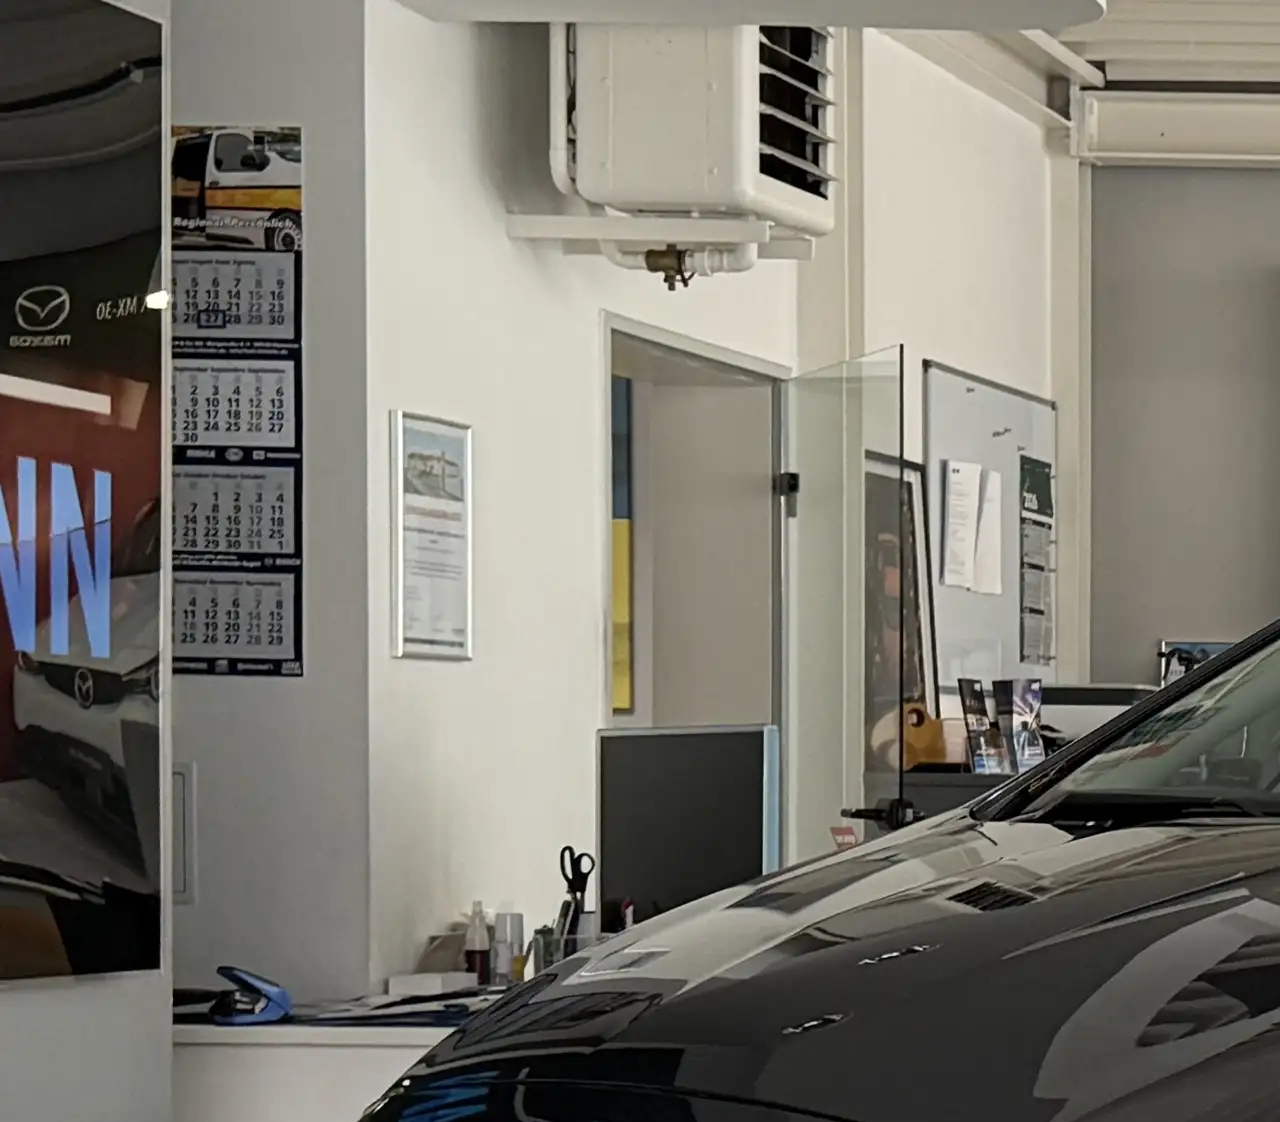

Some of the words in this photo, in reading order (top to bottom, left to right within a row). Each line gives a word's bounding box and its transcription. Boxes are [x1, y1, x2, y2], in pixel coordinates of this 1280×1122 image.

[191, 277, 199, 288] 5
[212, 277, 220, 288] 6
[234, 278, 241, 288] 7
[276, 278, 285, 289] 9
[184, 289, 198, 299] 12
[205, 290, 219, 300] 13
[227, 290, 241, 300] 14
[249, 290, 262, 301] 15
[270, 290, 284, 301] 16
[184, 301, 199, 311] 19
[205, 301, 220, 311] 20
[226, 302, 240, 312] 21
[249, 302, 262, 313] 22
[268, 303, 284, 314] 23
[183, 313, 197, 323] 26
[205, 313, 219, 323] 27
[226, 314, 241, 324] 28
[247, 314, 263, 325] 29
[268, 314, 285, 325] 30
[190, 385, 198, 396] 2
[212, 385, 219, 396] 3
[232, 385, 241, 396] 4
[254, 386, 262, 396] 5
[276, 386, 284, 397] 6
[191, 396, 199, 408] 9
[205, 397, 220, 408] 10
[227, 398, 240, 408] 11
[249, 398, 262, 408] 12
[271, 398, 284, 409] 13
[184, 408, 198, 419] 16
[205, 409, 219, 420] 17
[226, 409, 241, 420] 18
[248, 410, 263, 420] 19
[268, 410, 284, 421] 20
[183, 420, 198, 431] 23
[203, 421, 219, 432] 24
[225, 421, 241, 432] 25
[247, 422, 262, 432] 26
[268, 422, 284, 433] 27
[183, 432, 198, 442] 30
[212, 492, 219, 502] 1
[233, 492, 241, 502] 2
[255, 492, 262, 503] 3
[276, 493, 284, 503] 4
[190, 502, 198, 513] 7
[211, 503, 219, 514] 8
[233, 504, 241, 514] 9
[249, 505, 263, 514] 10
[271, 505, 284, 515] 11
[184, 515, 197, 525] 14
[205, 515, 219, 526] 15
[226, 515, 241, 526] 16
[248, 516, 262, 526] 17
[270, 516, 284, 527] 18
[183, 527, 197, 537] 21
[203, 527, 219, 537] 22
[225, 528, 241, 538] 23
[247, 528, 262, 538] 24
[268, 528, 284, 539] 25
[183, 539, 198, 548] 28
[204, 539, 219, 549] 29
[225, 540, 241, 549] 30
[248, 540, 262, 550] 31
[277, 540, 283, 550] 1
[188, 597, 196, 608] 4
[210, 597, 218, 608] 5
[232, 598, 240, 609] 6
[254, 600, 262, 609] 7
[276, 600, 283, 610] 8
[183, 609, 196, 619] 11
[205, 610, 218, 620] 12
[225, 610, 240, 621] 13
[248, 611, 261, 621] 14
[269, 611, 283, 621] 15
[183, 621, 196, 631] 18
[204, 622, 219, 632] 19
[224, 622, 240, 633] 20
[247, 623, 261, 633] 21
[268, 623, 283, 634] 22
[181, 633, 197, 643] 25
[202, 633, 219, 644] 26
[224, 634, 240, 644] 27
[246, 634, 262, 645] 28
[268, 635, 283, 646] 29
